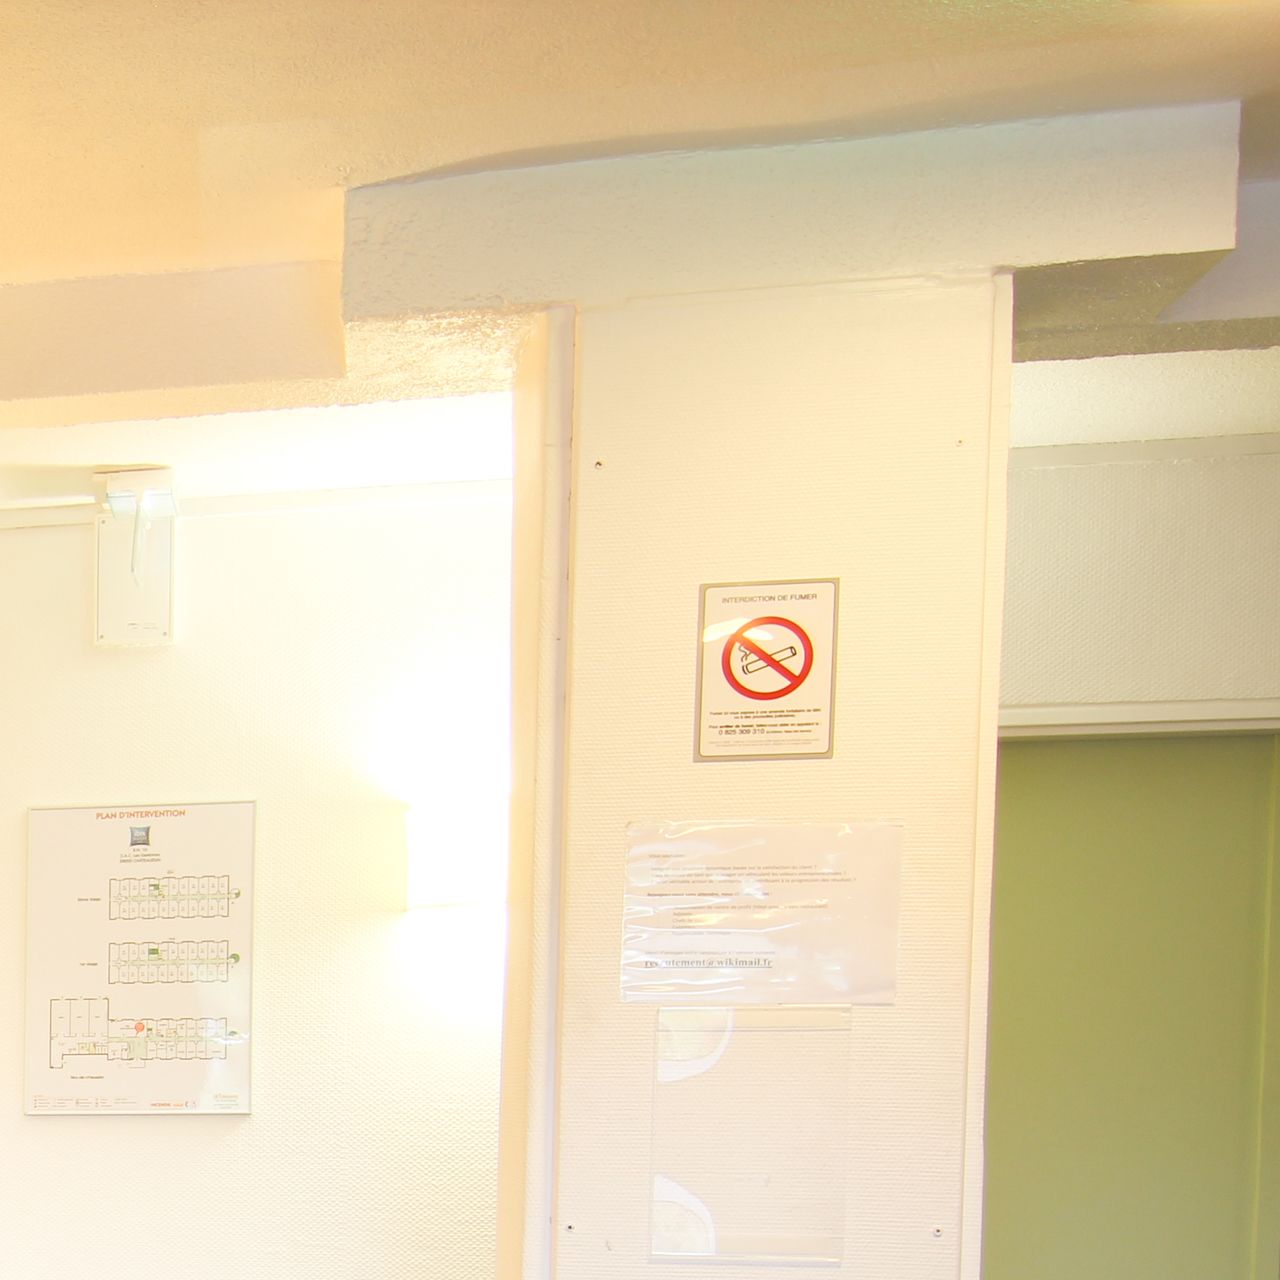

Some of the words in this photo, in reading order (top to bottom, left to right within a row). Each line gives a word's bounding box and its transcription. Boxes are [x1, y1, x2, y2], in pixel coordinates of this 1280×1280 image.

[722, 595, 775, 604] INTERDICTION
[790, 593, 817, 601] FUMER
[96, 812, 117, 820] PLAN
[119, 810, 186, 819] D'INTERVENTION
[645, 958, 772, 968] recutement@wikimail.fr
